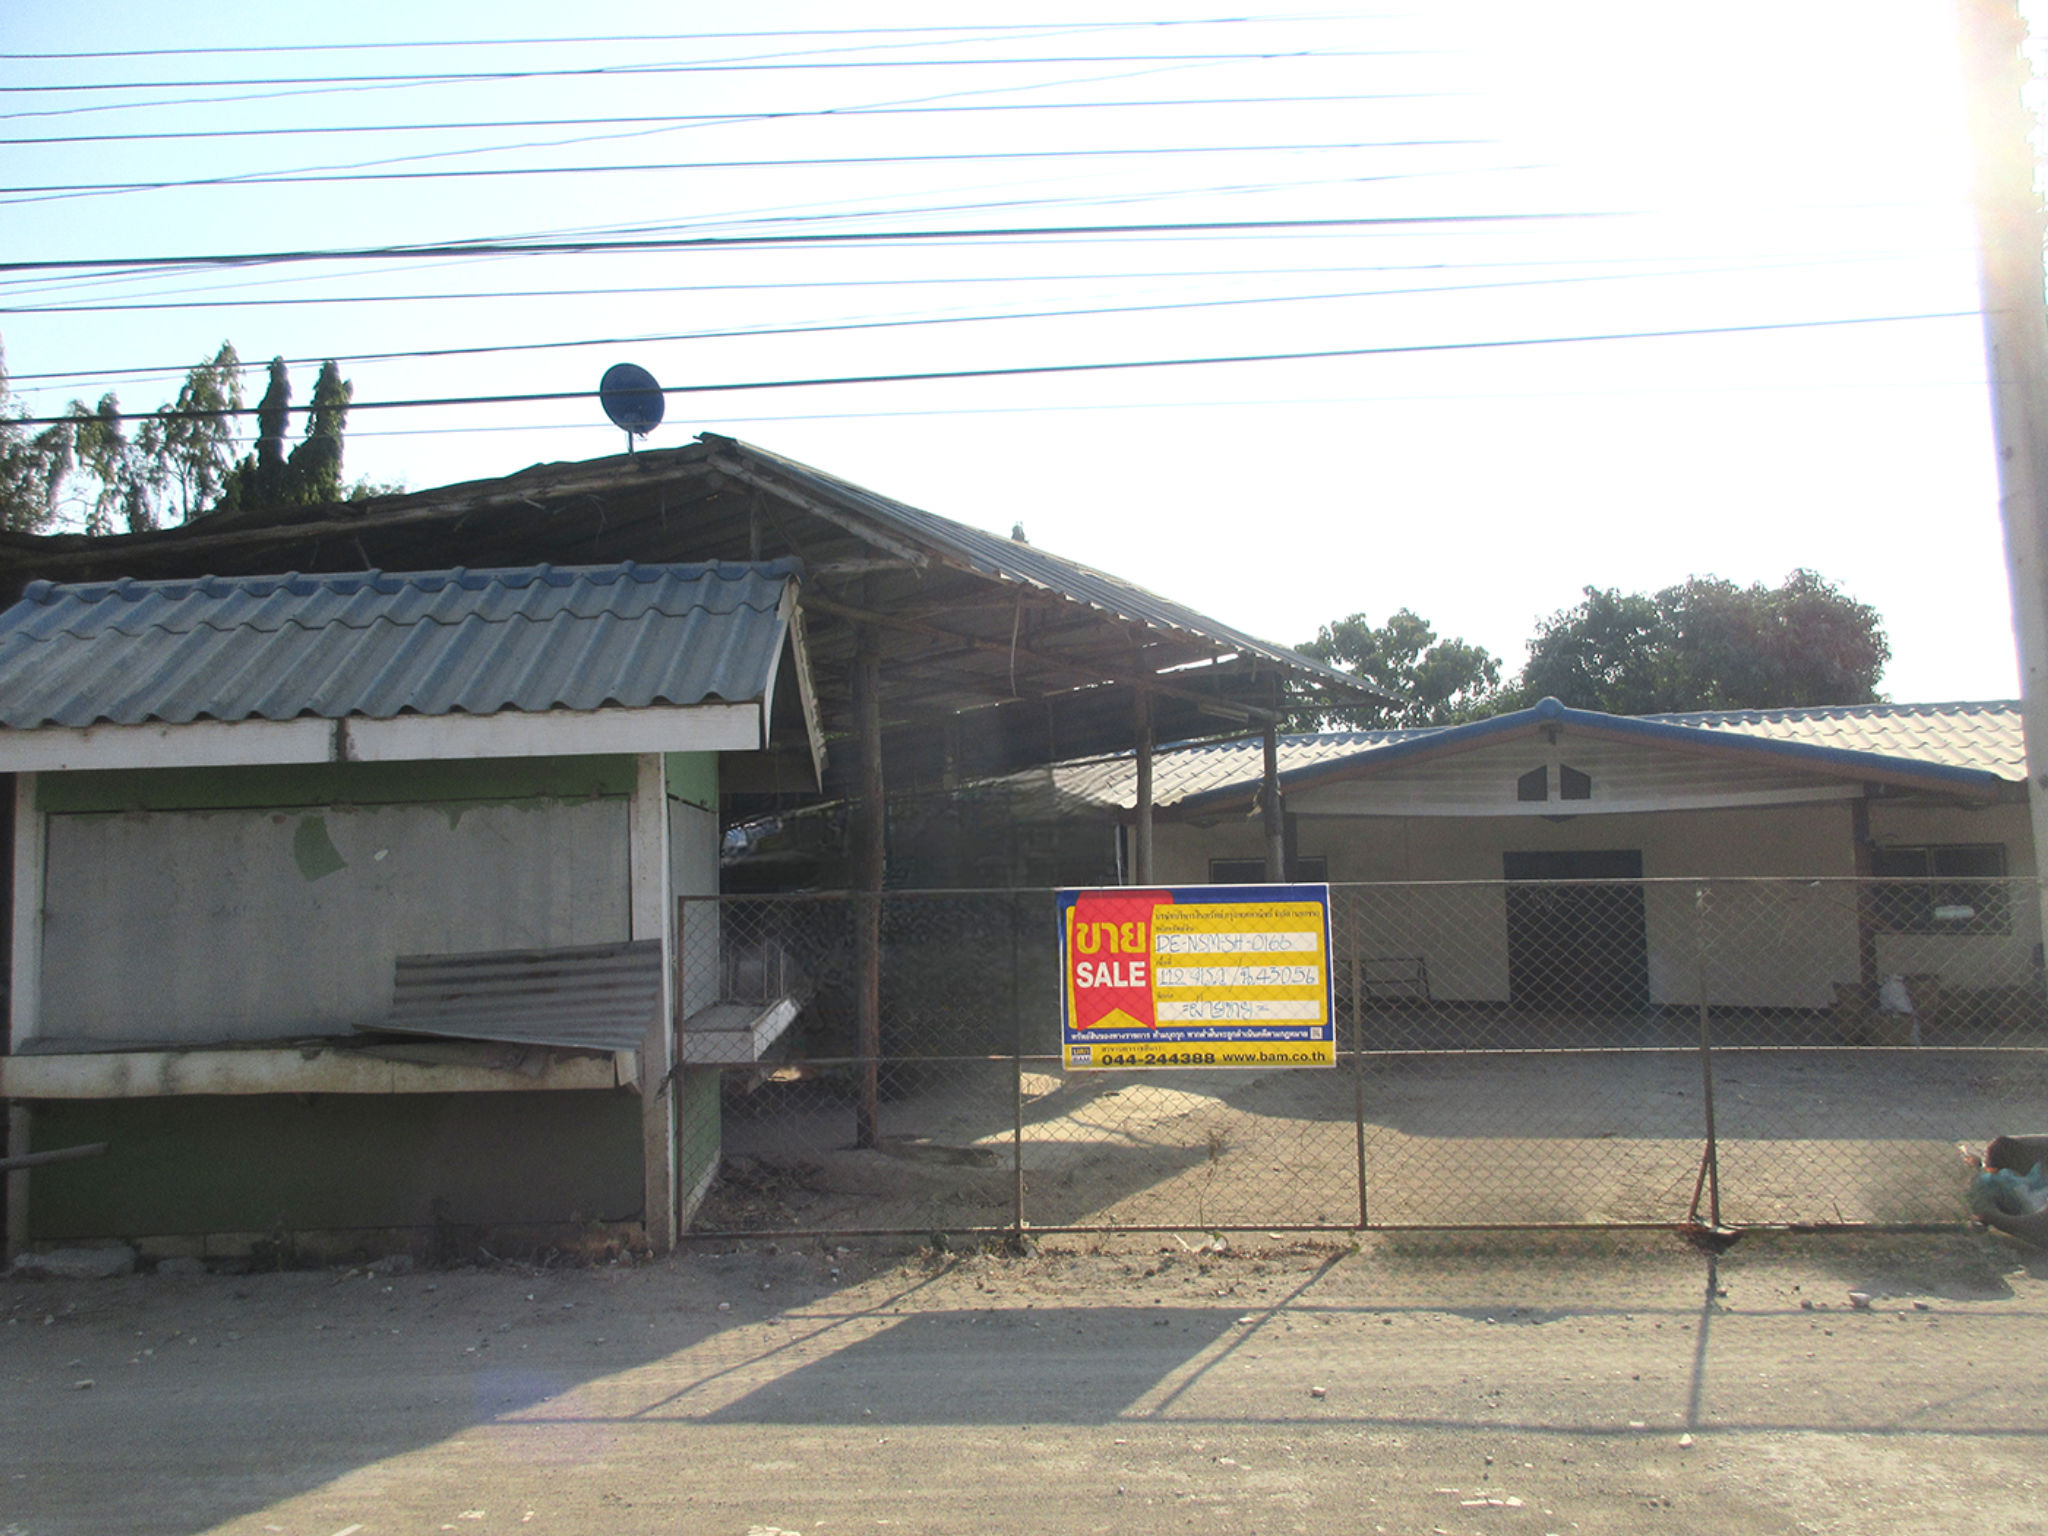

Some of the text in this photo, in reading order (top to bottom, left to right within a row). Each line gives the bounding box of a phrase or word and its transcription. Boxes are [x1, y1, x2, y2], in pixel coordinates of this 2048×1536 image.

[1076, 921, 1146, 955] ขาย
[1076, 961, 1146, 988] SALE
[1102, 1051, 1325, 1066] 044-244388 www.bam.co.th
